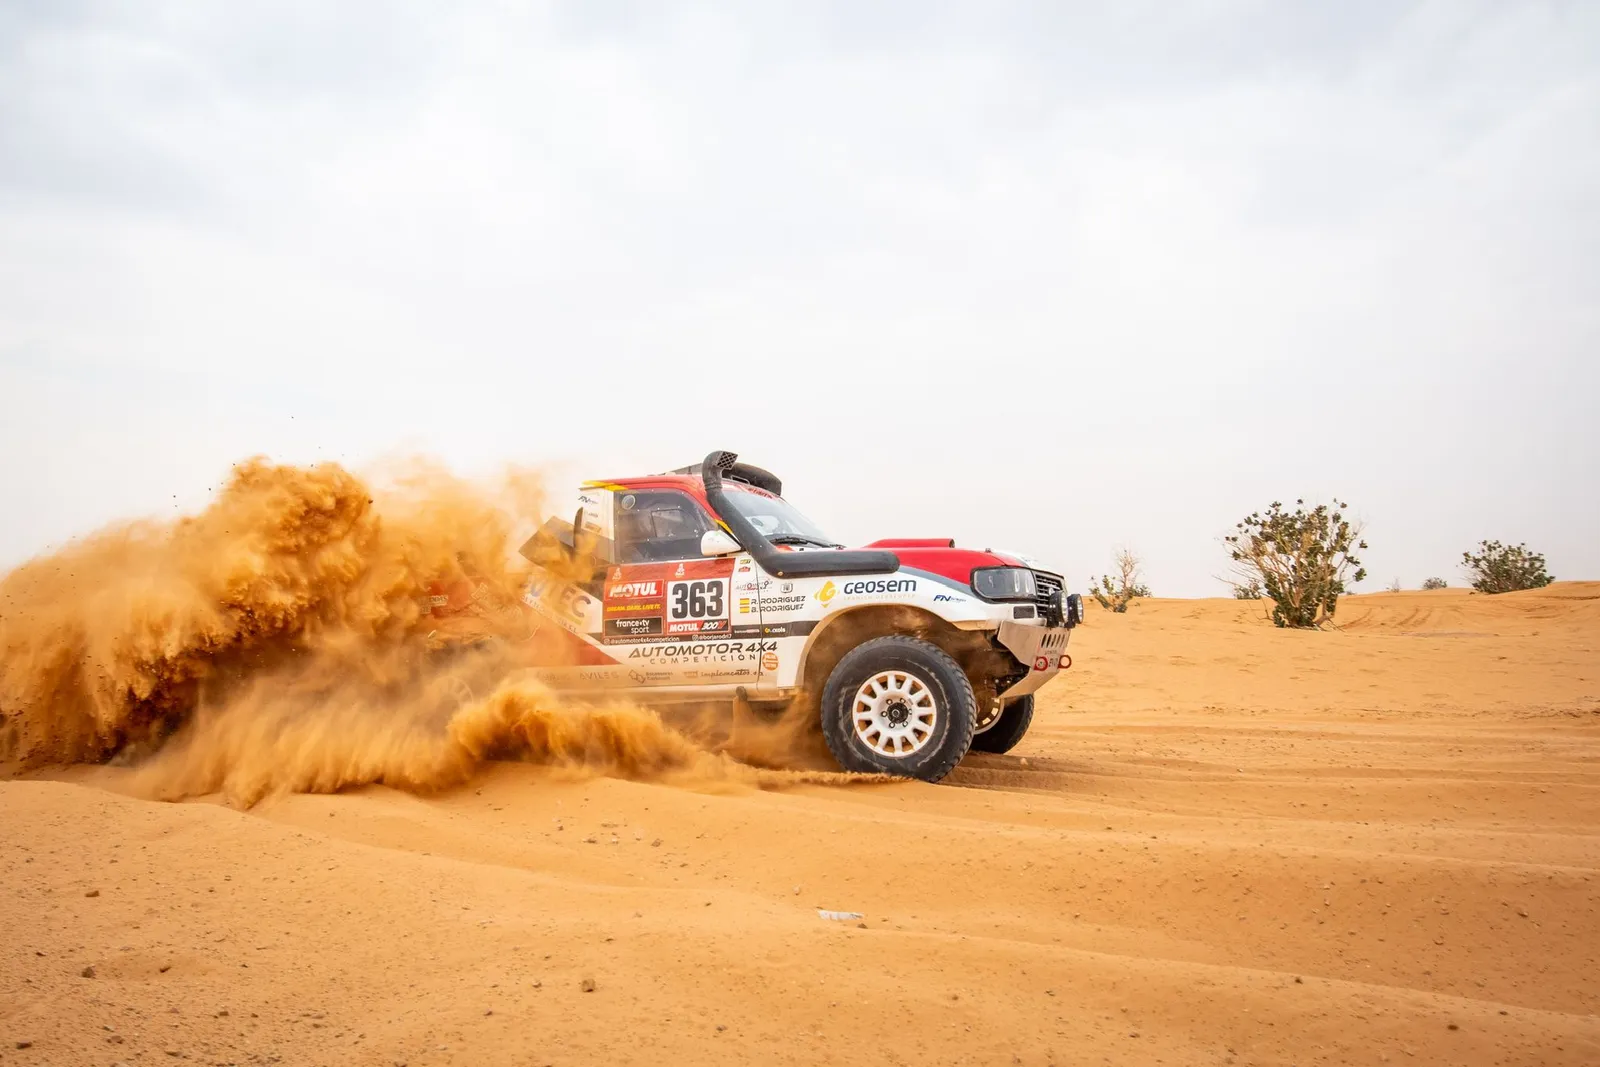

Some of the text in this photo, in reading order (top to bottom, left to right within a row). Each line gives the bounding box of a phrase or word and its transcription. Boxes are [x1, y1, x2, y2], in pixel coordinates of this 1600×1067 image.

[609, 581, 658, 598] MOTUL
[671, 580, 724, 619] 363
[760, 595, 806, 605] RODRIGUEZ
[760, 603, 804, 613] RODRIGUEZ
[630, 627, 650, 635] sport
[669, 620, 727, 633] MOTUL 300V
[628, 642, 744, 659] AUTOMOTOR
